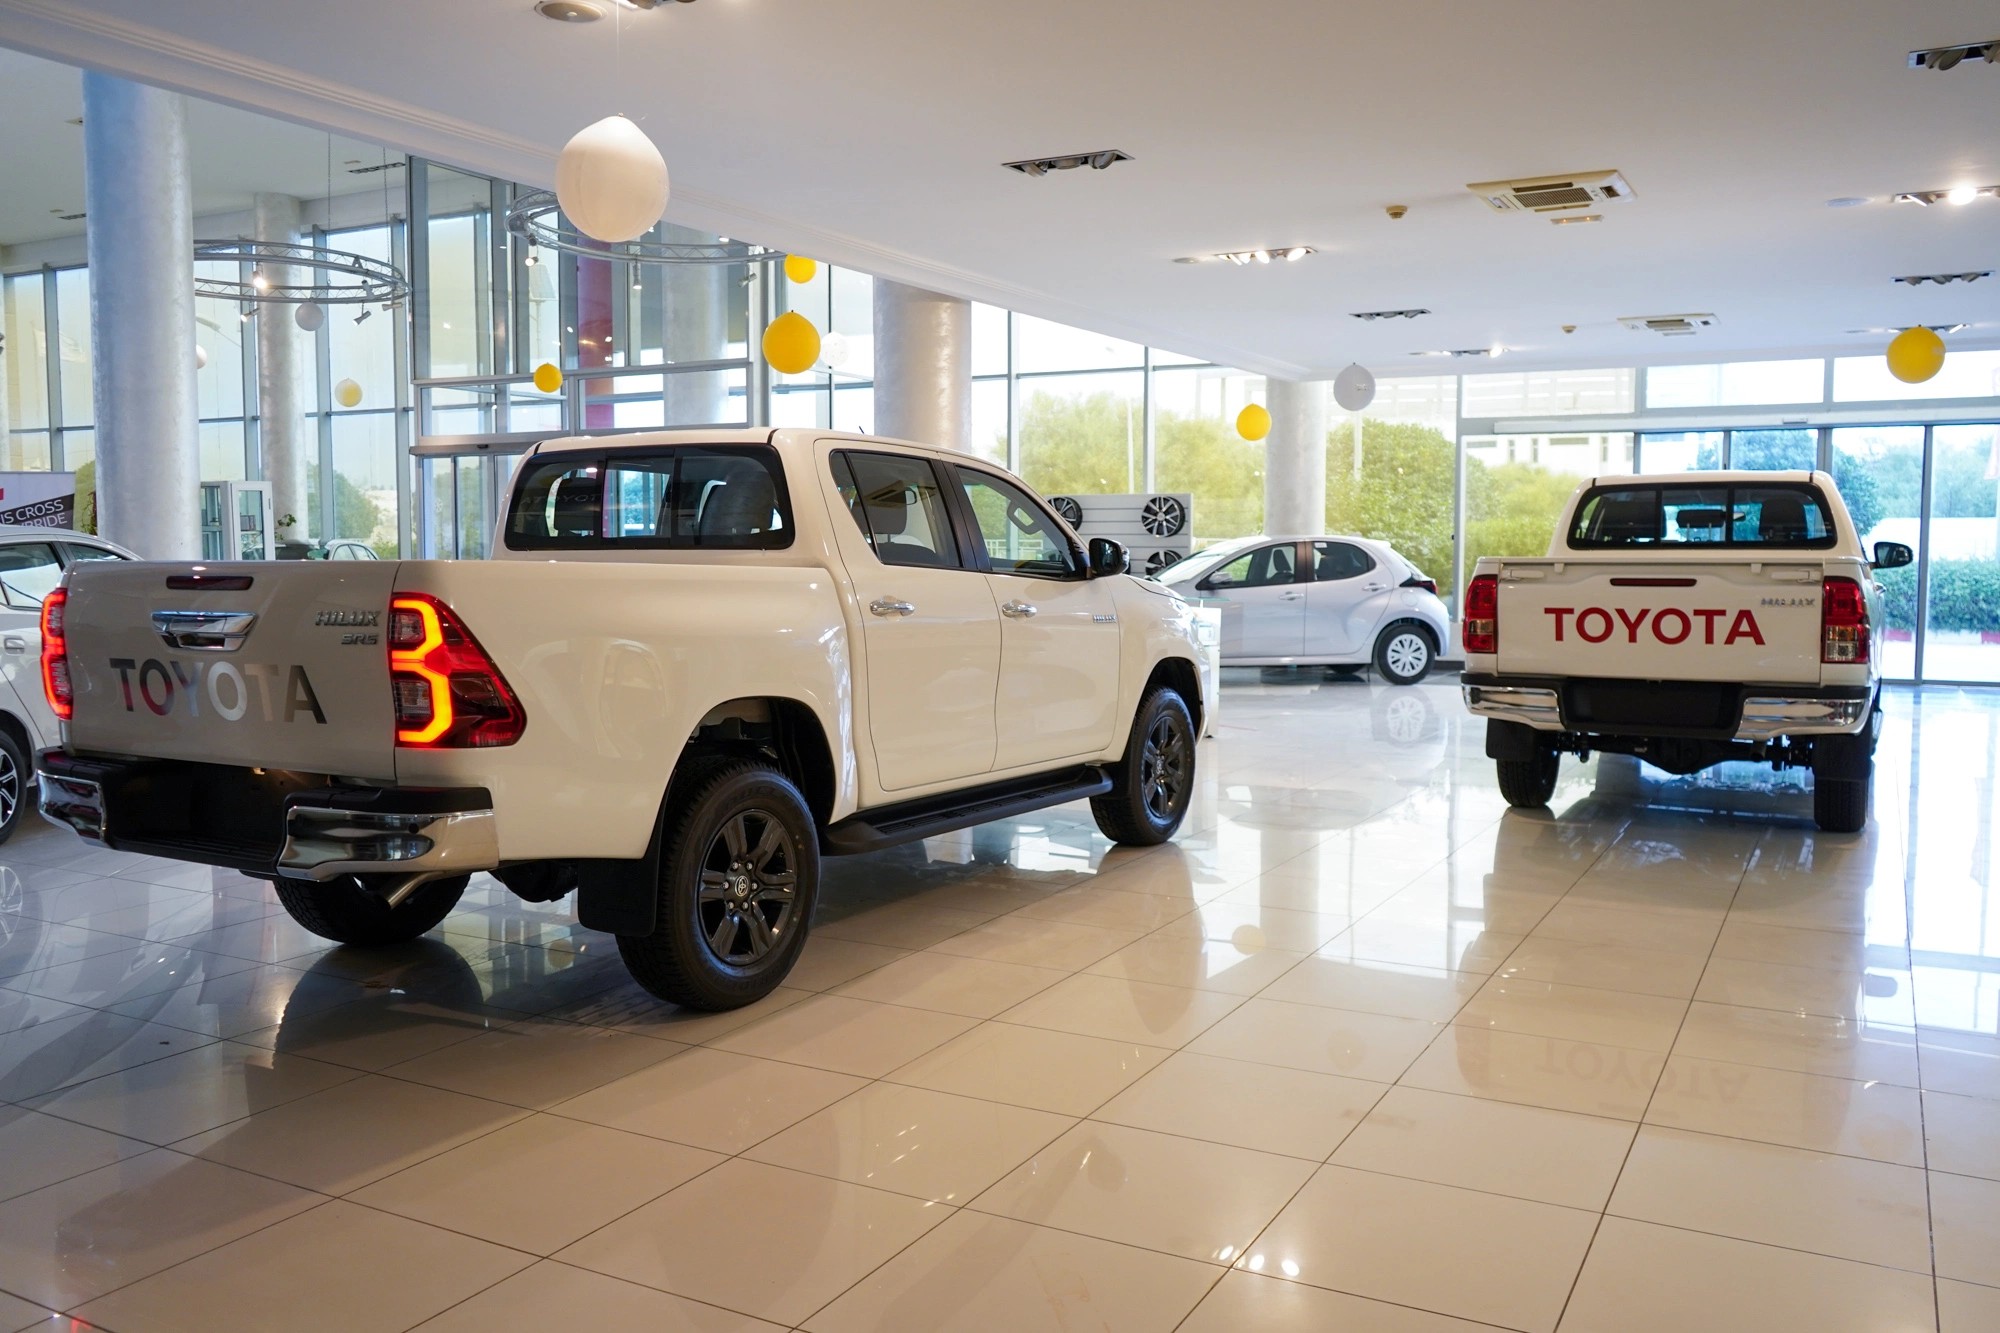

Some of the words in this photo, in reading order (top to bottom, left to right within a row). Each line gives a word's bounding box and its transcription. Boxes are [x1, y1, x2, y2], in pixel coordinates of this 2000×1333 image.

[15, 499, 64, 521] CROSS
[315, 610, 381, 626] HILUX
[1544, 607, 1766, 645] TOYOTA
[109, 658, 328, 724] TOYOTA
